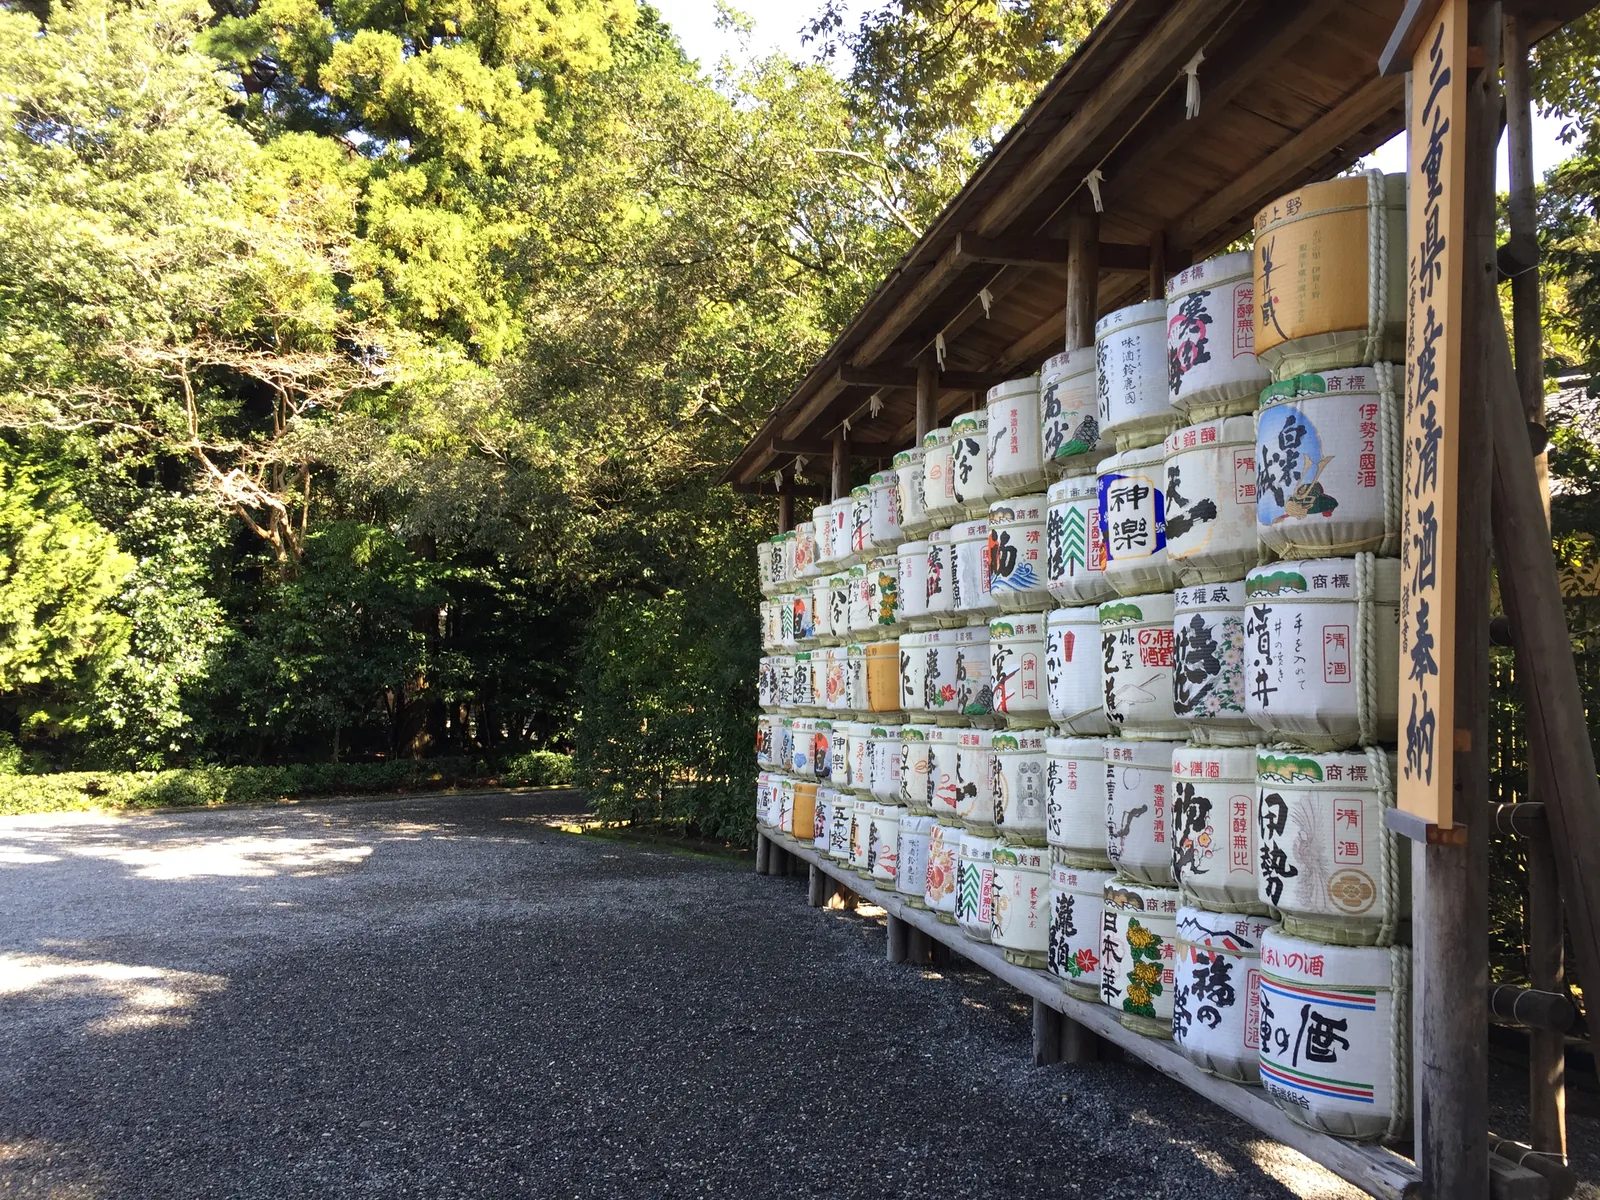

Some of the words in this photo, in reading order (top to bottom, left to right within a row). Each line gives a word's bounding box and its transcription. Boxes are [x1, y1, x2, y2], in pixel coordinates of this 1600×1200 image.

[1327, 375, 1366, 391] 商標
[1405, 22, 1451, 786] 三重県産清酒奉納
[1016, 509, 1039, 520] 商標
[1026, 530, 1040, 560] 清酒
[1312, 574, 1350, 589] 商標
[1015, 624, 1037, 635] 商標
[1326, 632, 1347, 676] 清酒
[1024, 660, 1035, 690] 清酒
[1020, 739, 1041, 749] 商標
[1068, 761, 1077, 790] 日本酒
[1326, 764, 1368, 782] 商標
[1336, 808, 1360, 857] 清酒
[1146, 898, 1176, 913] 商標
